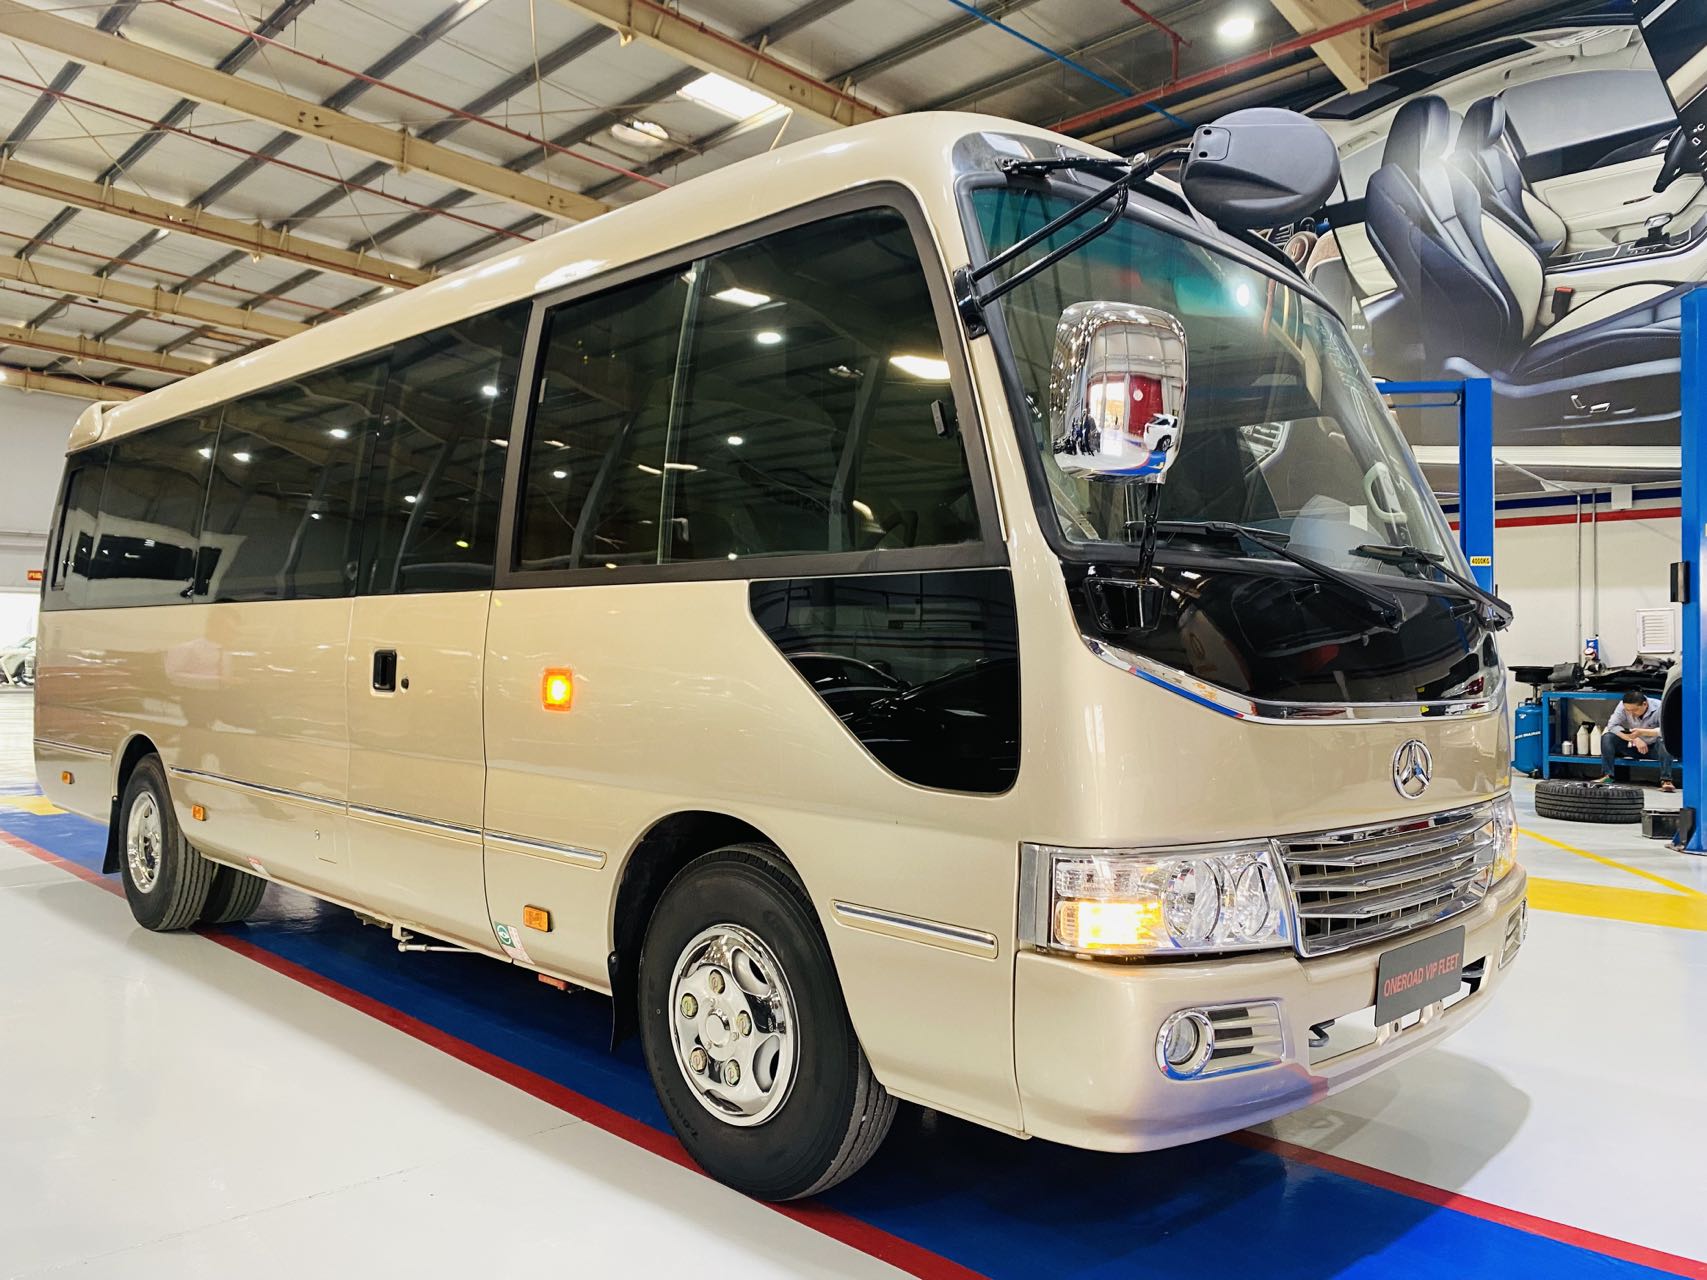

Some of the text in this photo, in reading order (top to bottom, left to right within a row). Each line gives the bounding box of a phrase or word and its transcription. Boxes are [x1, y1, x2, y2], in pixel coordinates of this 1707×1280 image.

[1383, 953, 1460, 998] ONEROAD VIP FLEET
